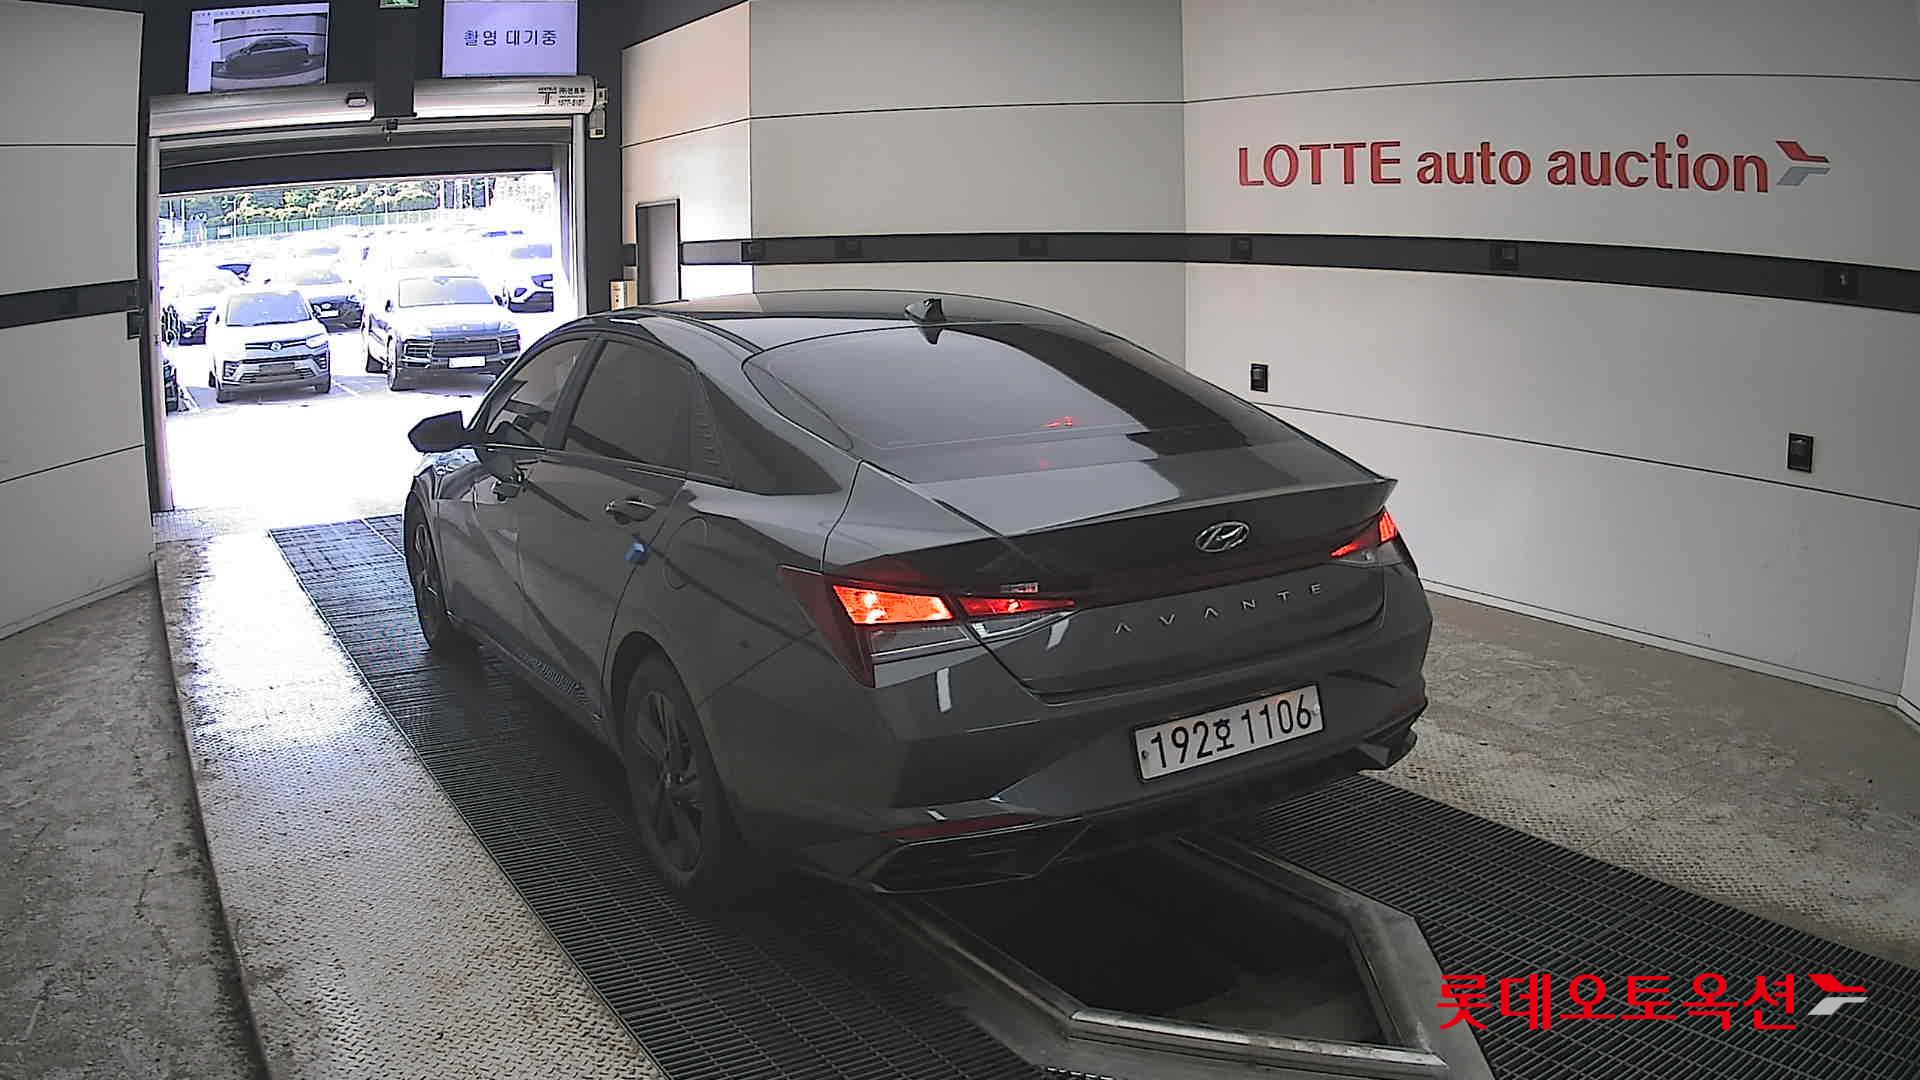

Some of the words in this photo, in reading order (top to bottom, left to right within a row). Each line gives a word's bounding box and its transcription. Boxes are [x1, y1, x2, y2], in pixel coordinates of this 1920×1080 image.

[505, 29, 557, 47] 대기중
[1238, 140, 1400, 188] LOTTE
[1416, 141, 1532, 186] auto
[1547, 134, 1769, 193] auction
[1114, 583, 1322, 634] AVANTE
[1151, 718, 1235, 768] 192호
[1241, 694, 1312, 744] 1106
